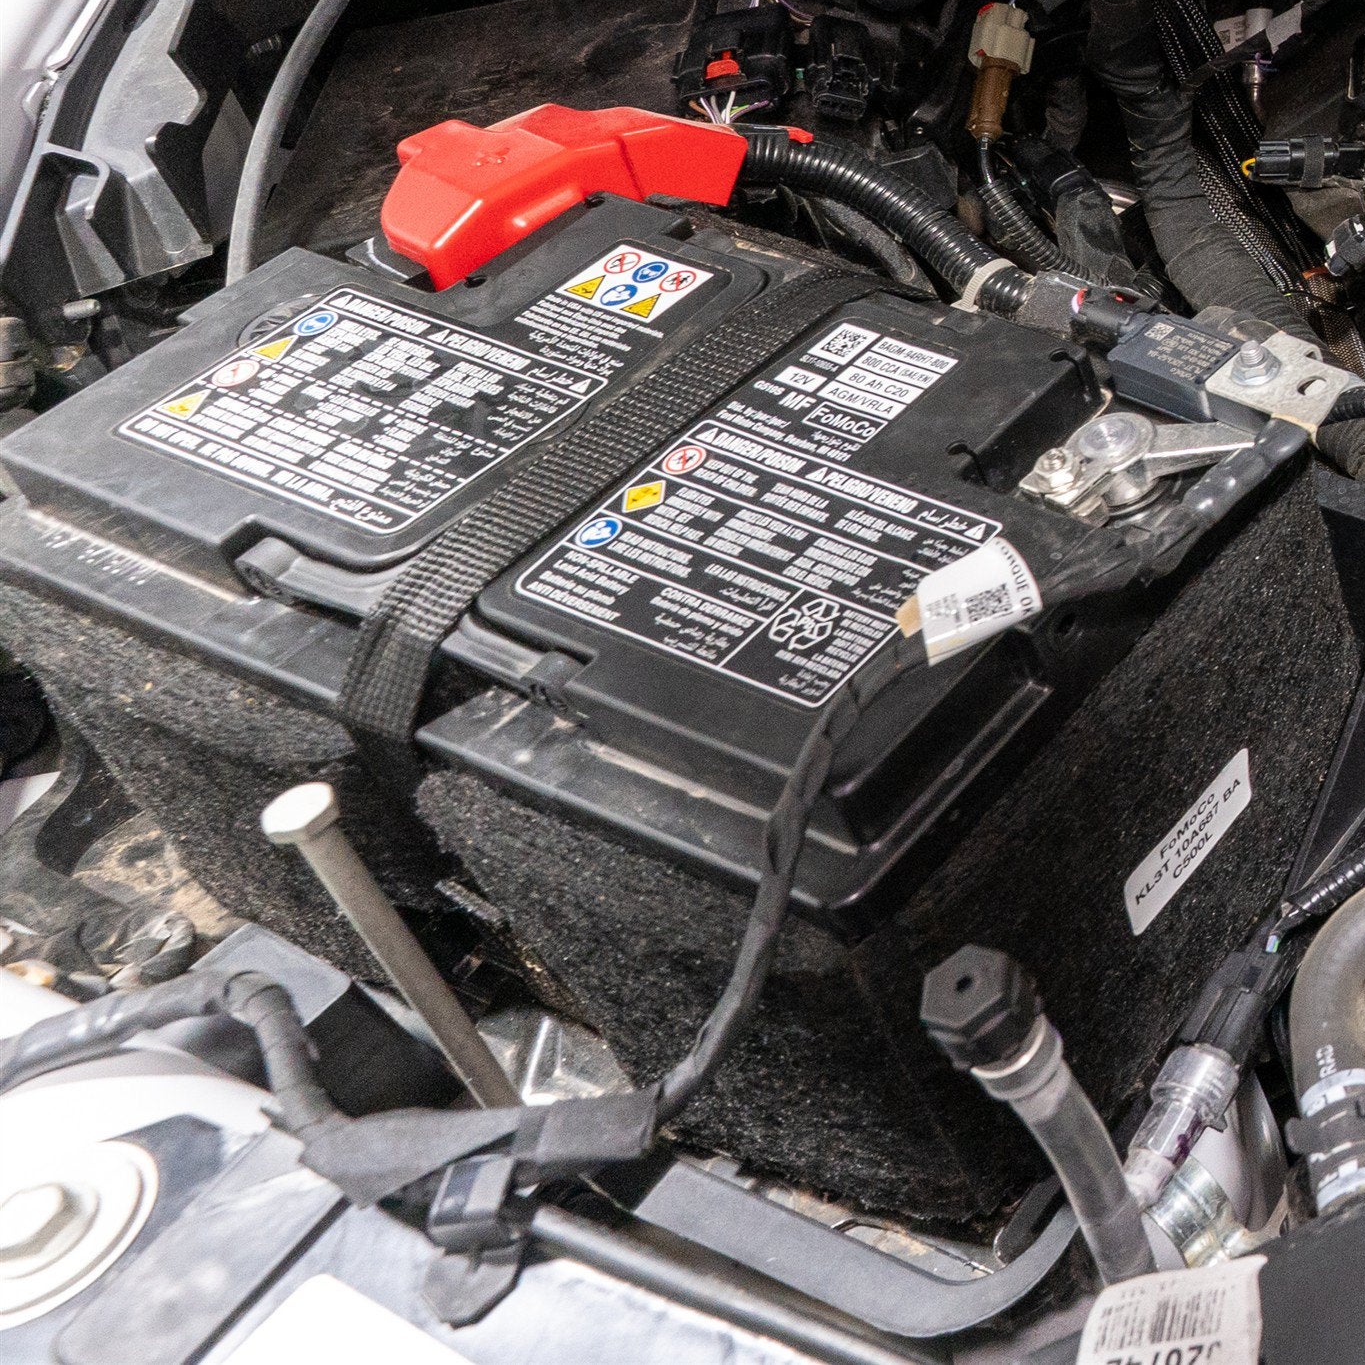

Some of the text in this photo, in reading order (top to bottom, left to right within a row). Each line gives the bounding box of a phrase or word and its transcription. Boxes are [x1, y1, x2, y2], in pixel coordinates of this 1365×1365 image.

[342, 299, 430, 334] DANGER/POISON
[442, 333, 531, 370] PELIGRO/VENENO
[790, 373, 813, 385] 12V
[849, 373, 909, 398] 80 Ah C20
[862, 356, 933, 383] 800 CCA (SAE/EN)
[778, 391, 817, 410] MF
[828, 387, 893, 414] AGM/VRLA
[810, 407, 876, 437] FoMoCo
[711, 432, 806, 473] DANGER/POISON
[821, 472, 918, 513] PELIGRO/VENENO
[564, 550, 639, 584] NON-SPILLABLE
[623, 547, 642, 559] LES
[526, 581, 554, 595] ANTI
[553, 559, 630, 595] Lead Acid Battery
[704, 564, 724, 575] LEA
[718, 569, 738, 581] LAS
[661, 587, 754, 628] CONTRA DERRAMES
[795, 616, 816, 631] Pb
[1134, 778, 1241, 906] KL3T 10A687 BA
[1160, 793, 1215, 860] FoMoCo
[1172, 831, 1214, 880] C500L
